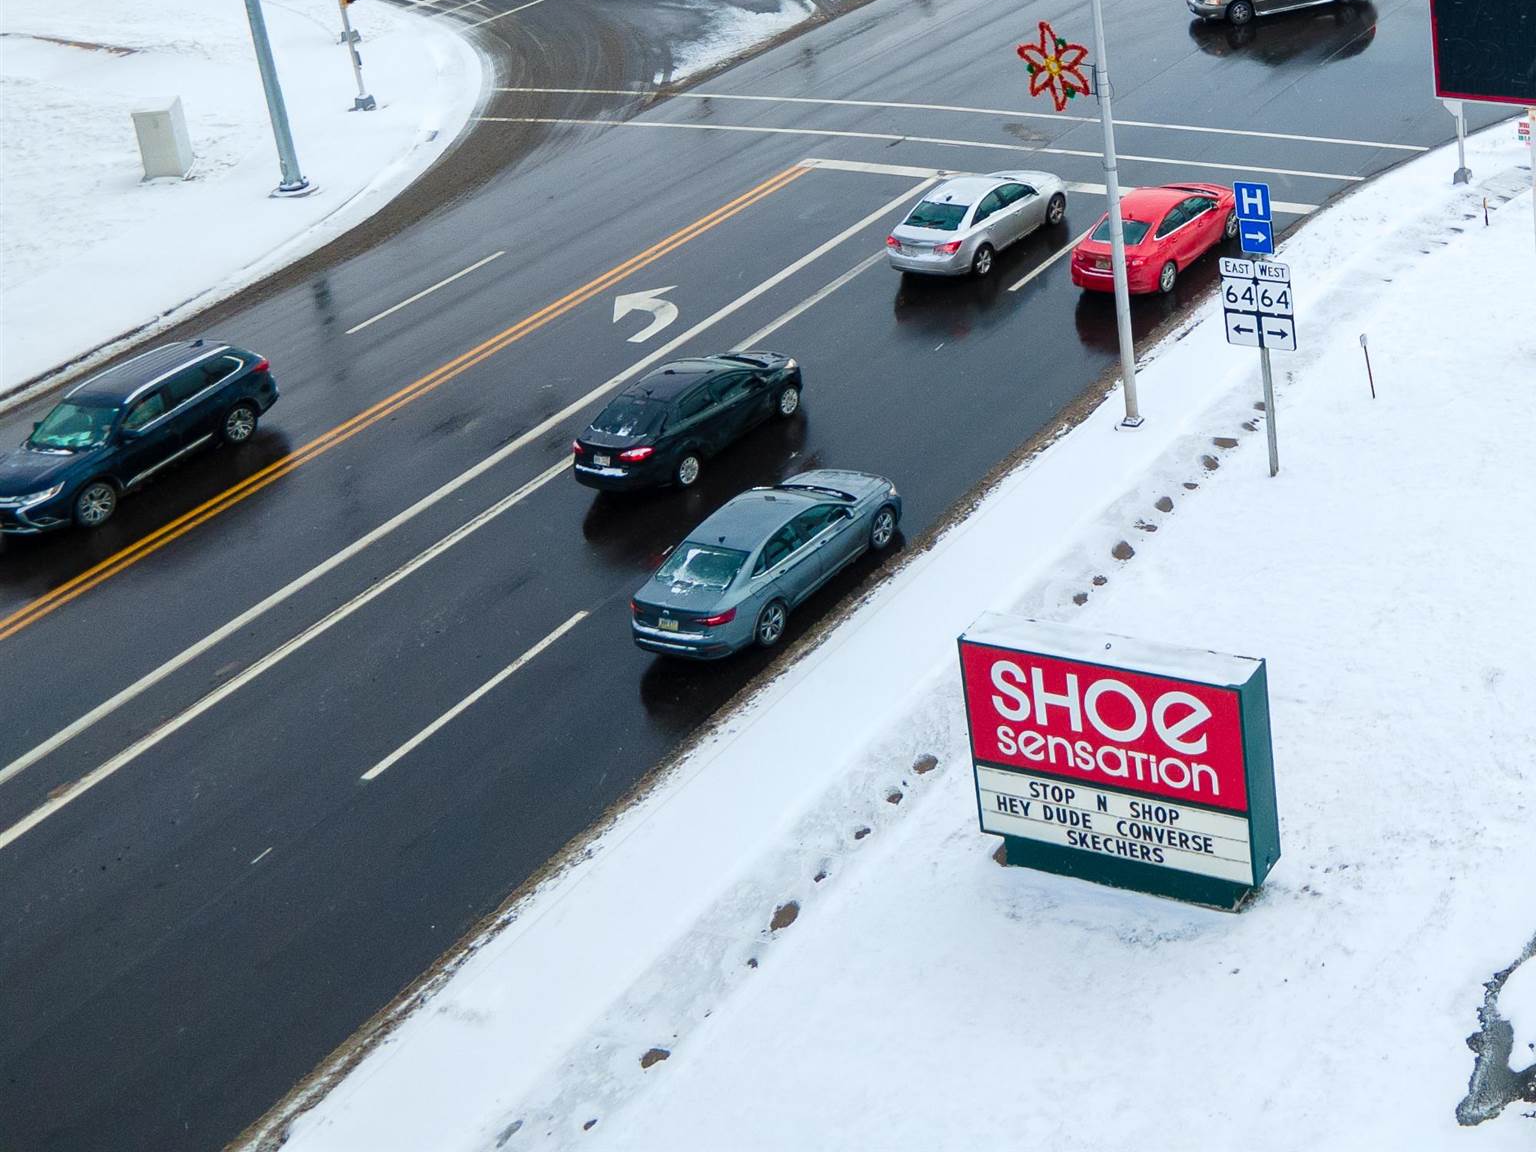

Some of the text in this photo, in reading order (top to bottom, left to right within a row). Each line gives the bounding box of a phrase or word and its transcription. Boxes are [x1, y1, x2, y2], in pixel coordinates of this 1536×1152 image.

[1241, 187, 1264, 216] H
[1224, 261, 1249, 275] EAST
[1258, 264, 1286, 278] WEST
[1225, 285, 1254, 306] 64
[1261, 289, 1290, 309] 64
[1029, 781, 1180, 826] STOP N SHOP
[996, 795, 1215, 854] HEY DUDE CONVERSE
[1066, 829, 1165, 864] SKECHERS
